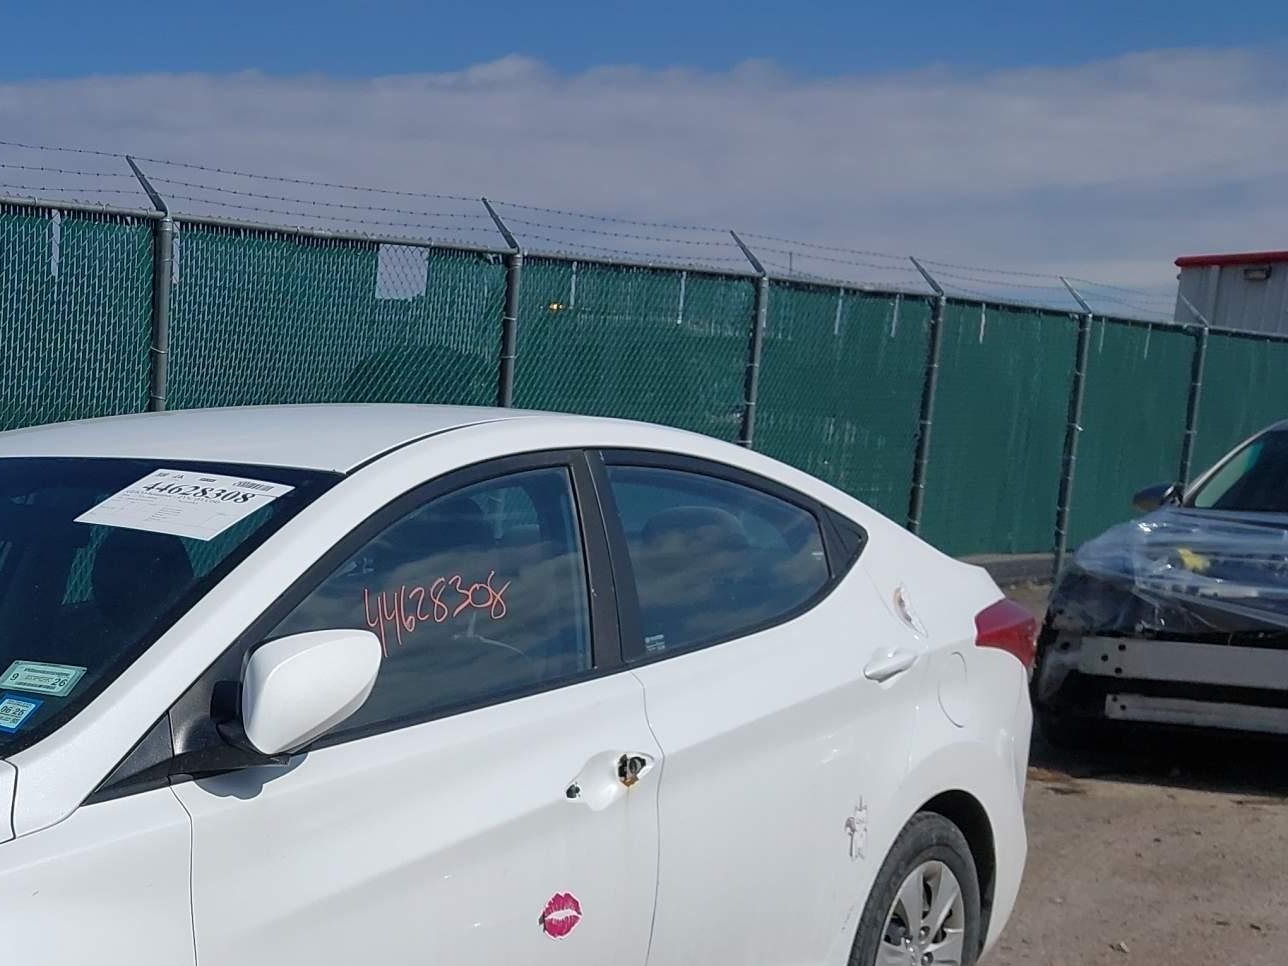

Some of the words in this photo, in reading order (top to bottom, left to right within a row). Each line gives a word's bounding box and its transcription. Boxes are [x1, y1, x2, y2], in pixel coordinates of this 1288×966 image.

[142, 481, 256, 504] 44628308
[364, 570, 512, 658] 44628308
[50, 678, 68, 688] 26
